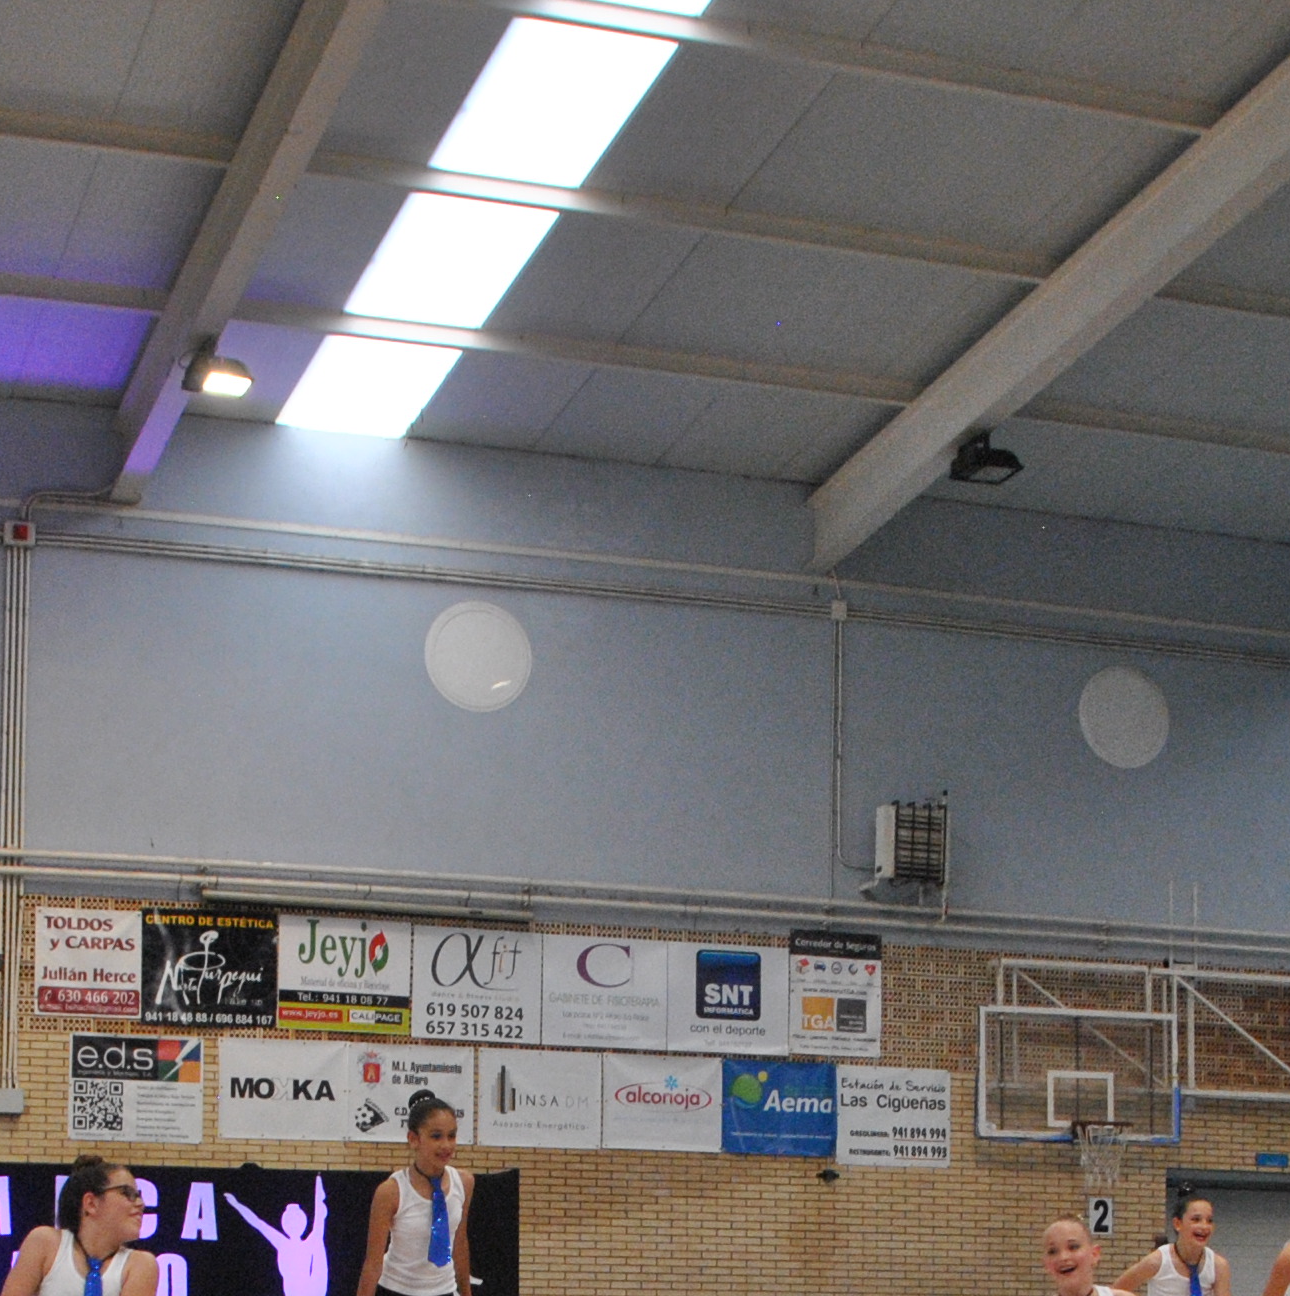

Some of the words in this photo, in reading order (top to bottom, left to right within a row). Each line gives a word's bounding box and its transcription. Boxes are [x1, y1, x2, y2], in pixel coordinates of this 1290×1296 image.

[44, 916, 113, 931] TOLDOS
[145, 915, 195, 926] CENTRO
[198, 917, 213, 926] DE
[217, 916, 274, 929] ESTÉTICA
[50, 938, 60, 951] y
[65, 936, 135, 951] CARPAS
[297, 918, 389, 978] Jeyjo
[42, 966, 87, 981] Julián
[93, 968, 136, 983] Herce
[58, 990, 81, 1002] 630
[85, 991, 108, 1004] 466
[112, 992, 136, 1005] 202
[322, 993, 341, 1003] 941
[346, 995, 358, 1004] 18
[376, 997, 389, 1006] 77
[704, 983, 753, 1006] SNT
[145, 1011, 163, 1022] 941
[167, 1011, 178, 1022] 18
[256, 1015, 274, 1025] 167
[351, 1011, 401, 1023] CALIPAGE
[426, 1002, 456, 1016] 619
[461, 1004, 490, 1018] 507
[494, 1006, 524, 1021] 824
[802, 1014, 835, 1029] TGA
[425, 1021, 455, 1035] 657
[460, 1022, 489, 1037] 315
[494, 1024, 523, 1039] 422
[690, 1025, 709, 1033] con
[713, 1024, 722, 1034] el
[725, 1025, 766, 1037] deporte
[77, 1041, 154, 1070] e.d.s
[411, 1062, 463, 1074] Ayuntamiento
[392, 1074, 401, 1085] de
[404, 1074, 429, 1086] Alfaro
[841, 1077, 884, 1090] Estación
[889, 1081, 902, 1091] de
[906, 1080, 946, 1093] Servicio
[519, 1094, 559, 1107] INSA
[763, 1089, 833, 1114] Aema
[840, 1093, 868, 1108] Las
[876, 1093, 946, 1113] Cigüeñas
[892, 1126, 908, 1138] 941
[910, 1127, 927, 1139] 894
[929, 1128, 946, 1140] 994
[893, 1144, 909, 1157] 941
[911, 1145, 928, 1157] 894
[931, 1146, 947, 1158] 993
[1093, 1199, 1109, 1233] 2
